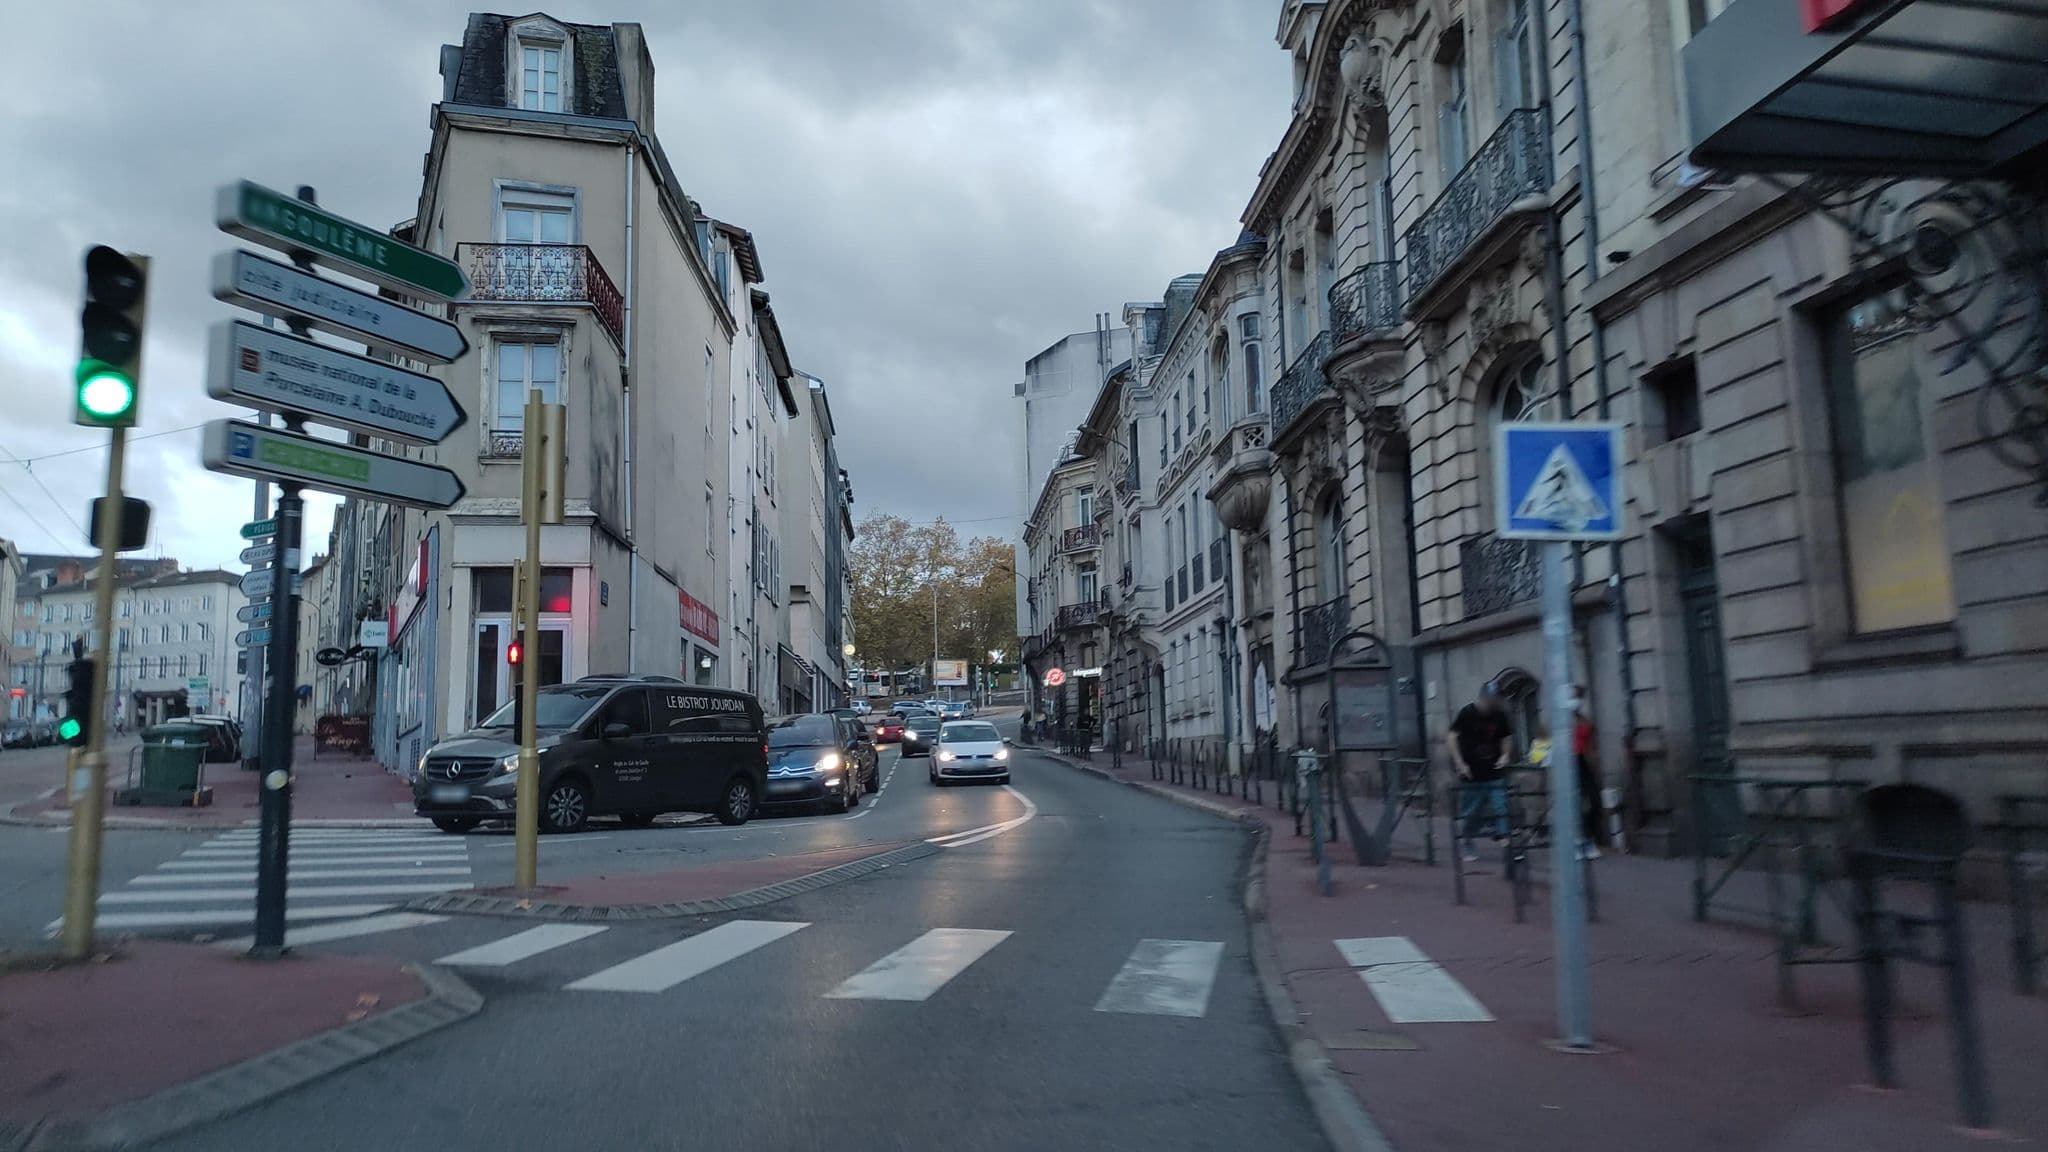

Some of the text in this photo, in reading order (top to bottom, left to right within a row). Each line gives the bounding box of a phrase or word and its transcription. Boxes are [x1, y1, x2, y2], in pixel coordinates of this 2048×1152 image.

[321, 364, 381, 390] national
[383, 380, 401, 397] de
[403, 382, 417, 402] la
[666, 695, 746, 712] LE BISTROT JOURDAN
